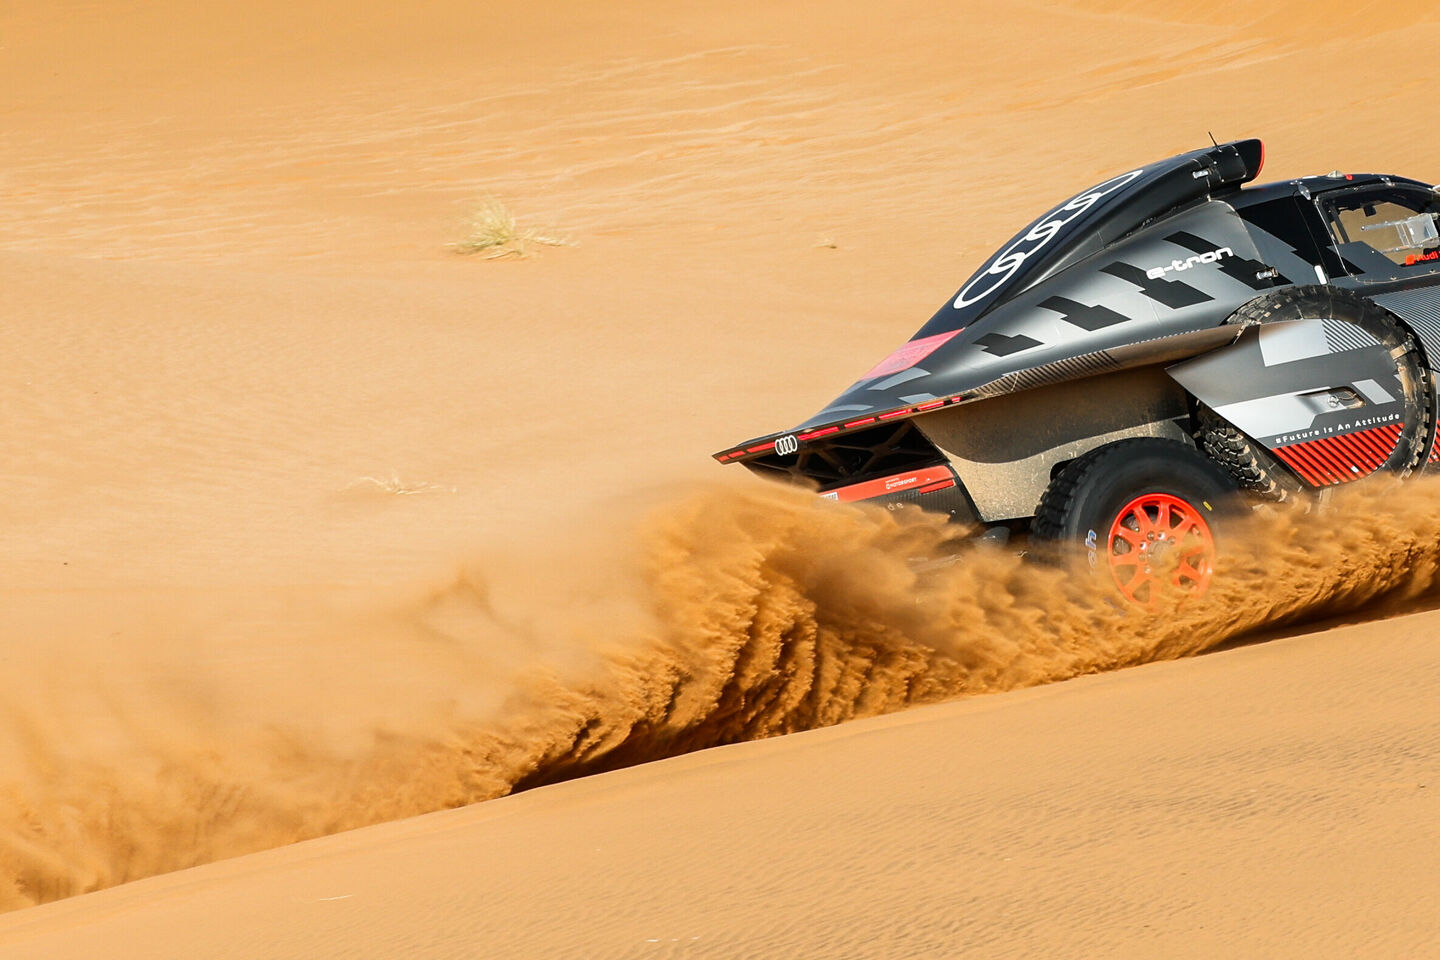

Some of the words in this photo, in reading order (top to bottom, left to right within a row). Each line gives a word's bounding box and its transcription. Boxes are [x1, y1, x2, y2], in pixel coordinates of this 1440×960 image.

[1145, 246, 1234, 280] e-tron
[1416, 250, 1438, 262] Audi
[1275, 430, 1320, 444] #Future
[1354, 413, 1400, 427] Attitude
